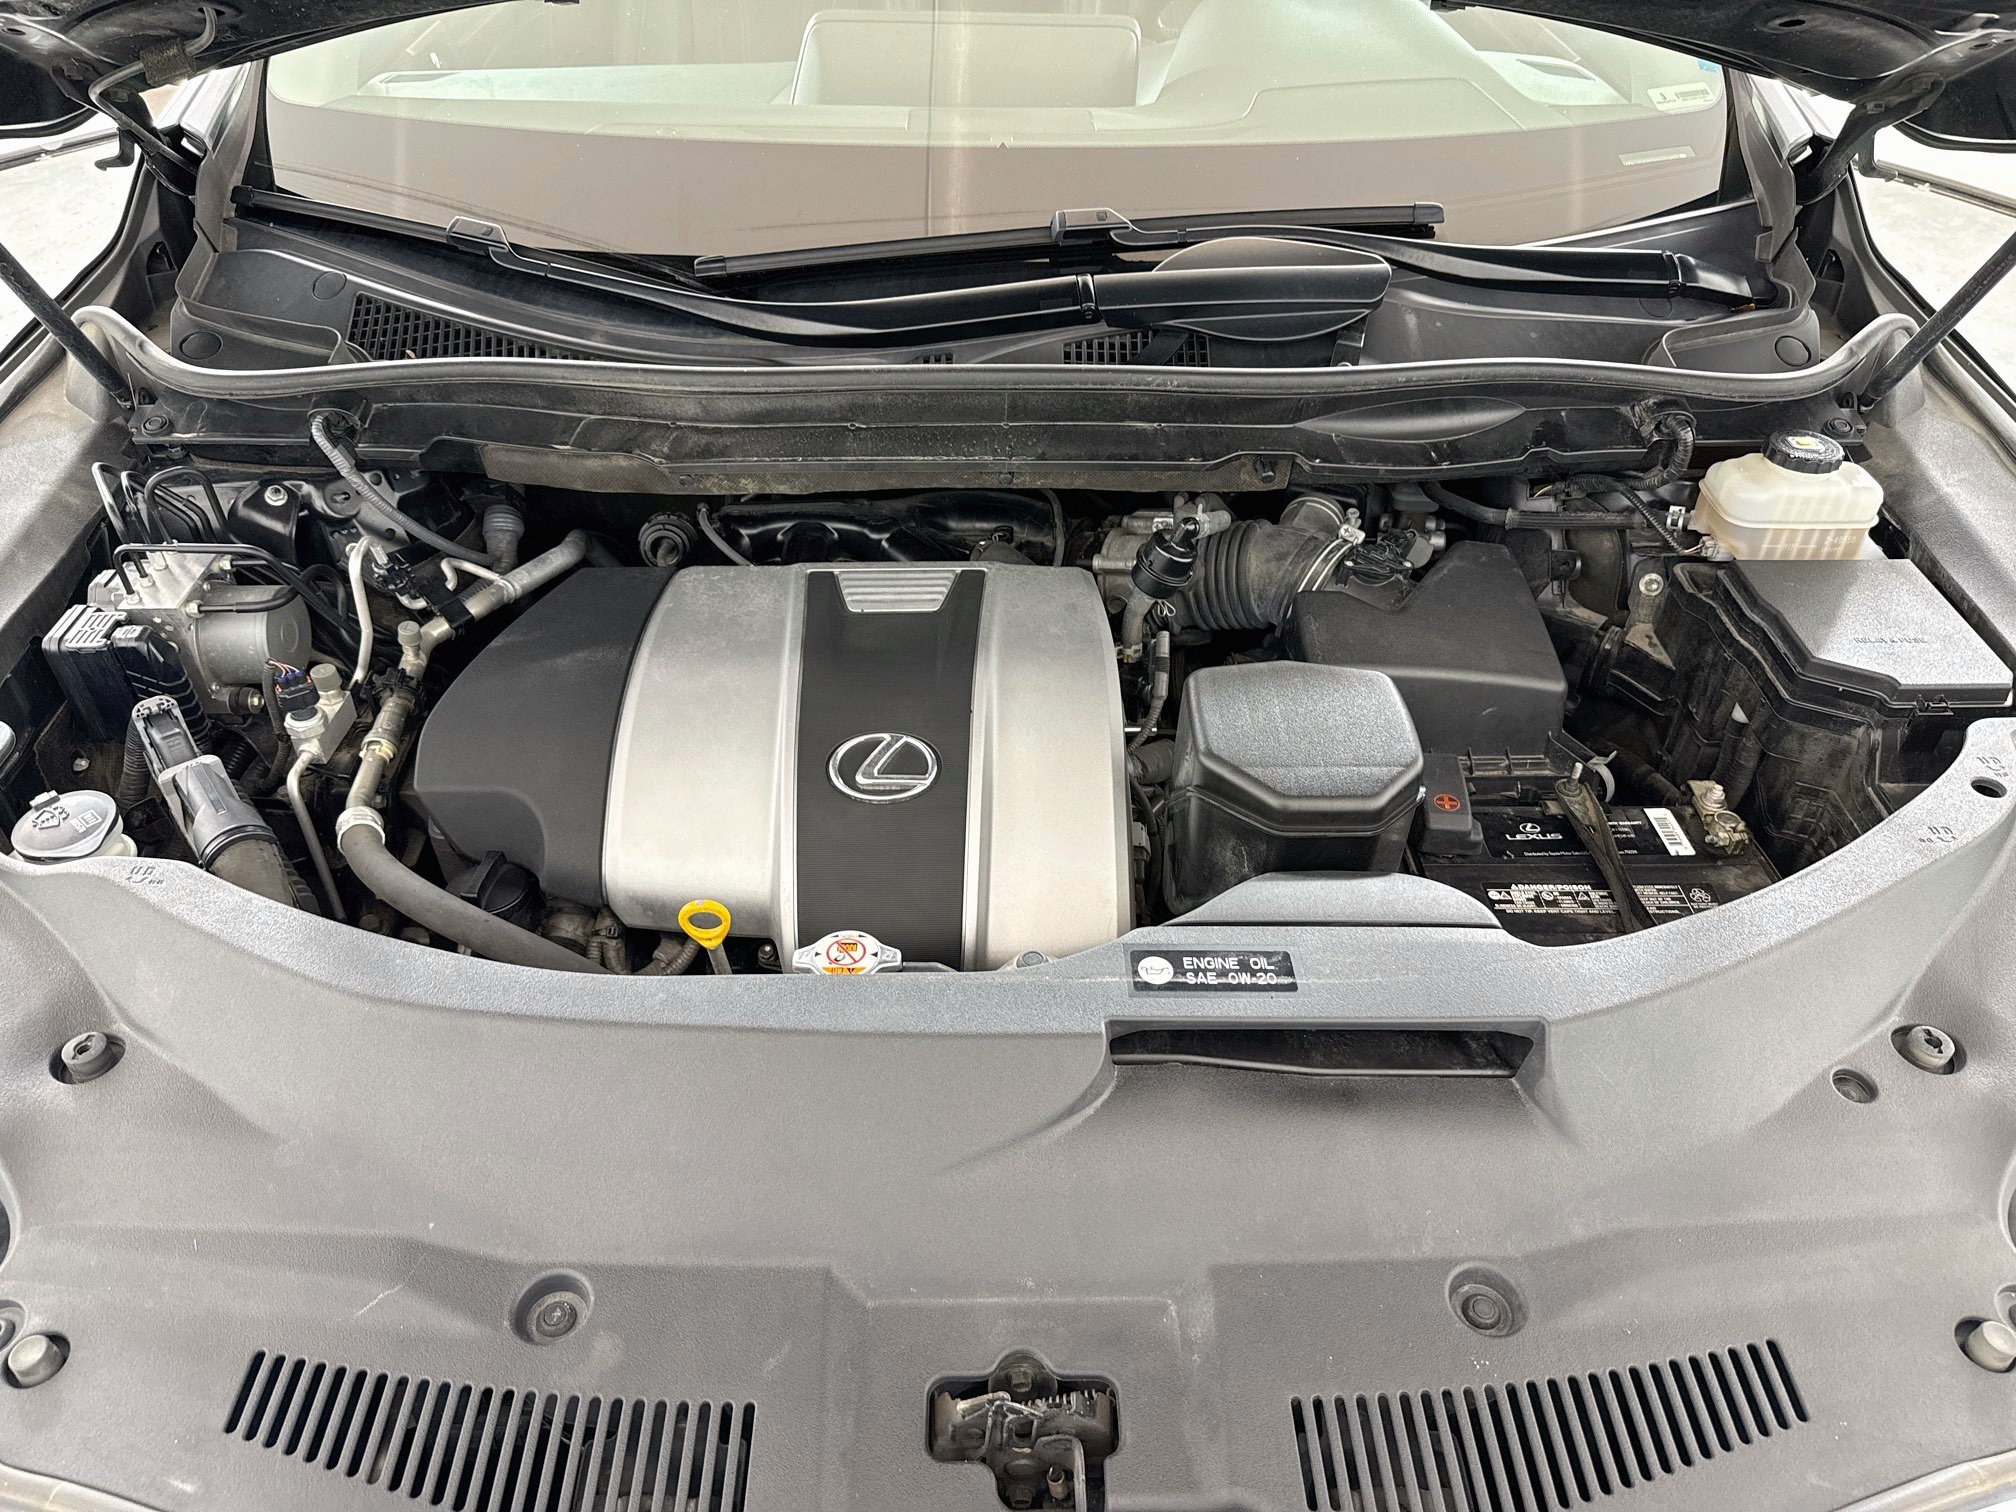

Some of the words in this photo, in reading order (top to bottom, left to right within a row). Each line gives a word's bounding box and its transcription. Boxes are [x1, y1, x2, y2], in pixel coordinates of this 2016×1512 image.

[1505, 832, 1563, 841] LEXUS
[1182, 957, 1240, 970] ENGINE
[1249, 957, 1276, 970] OIL
[1186, 972, 1218, 985] SAE
[1228, 972, 1277, 985] 0W-20
